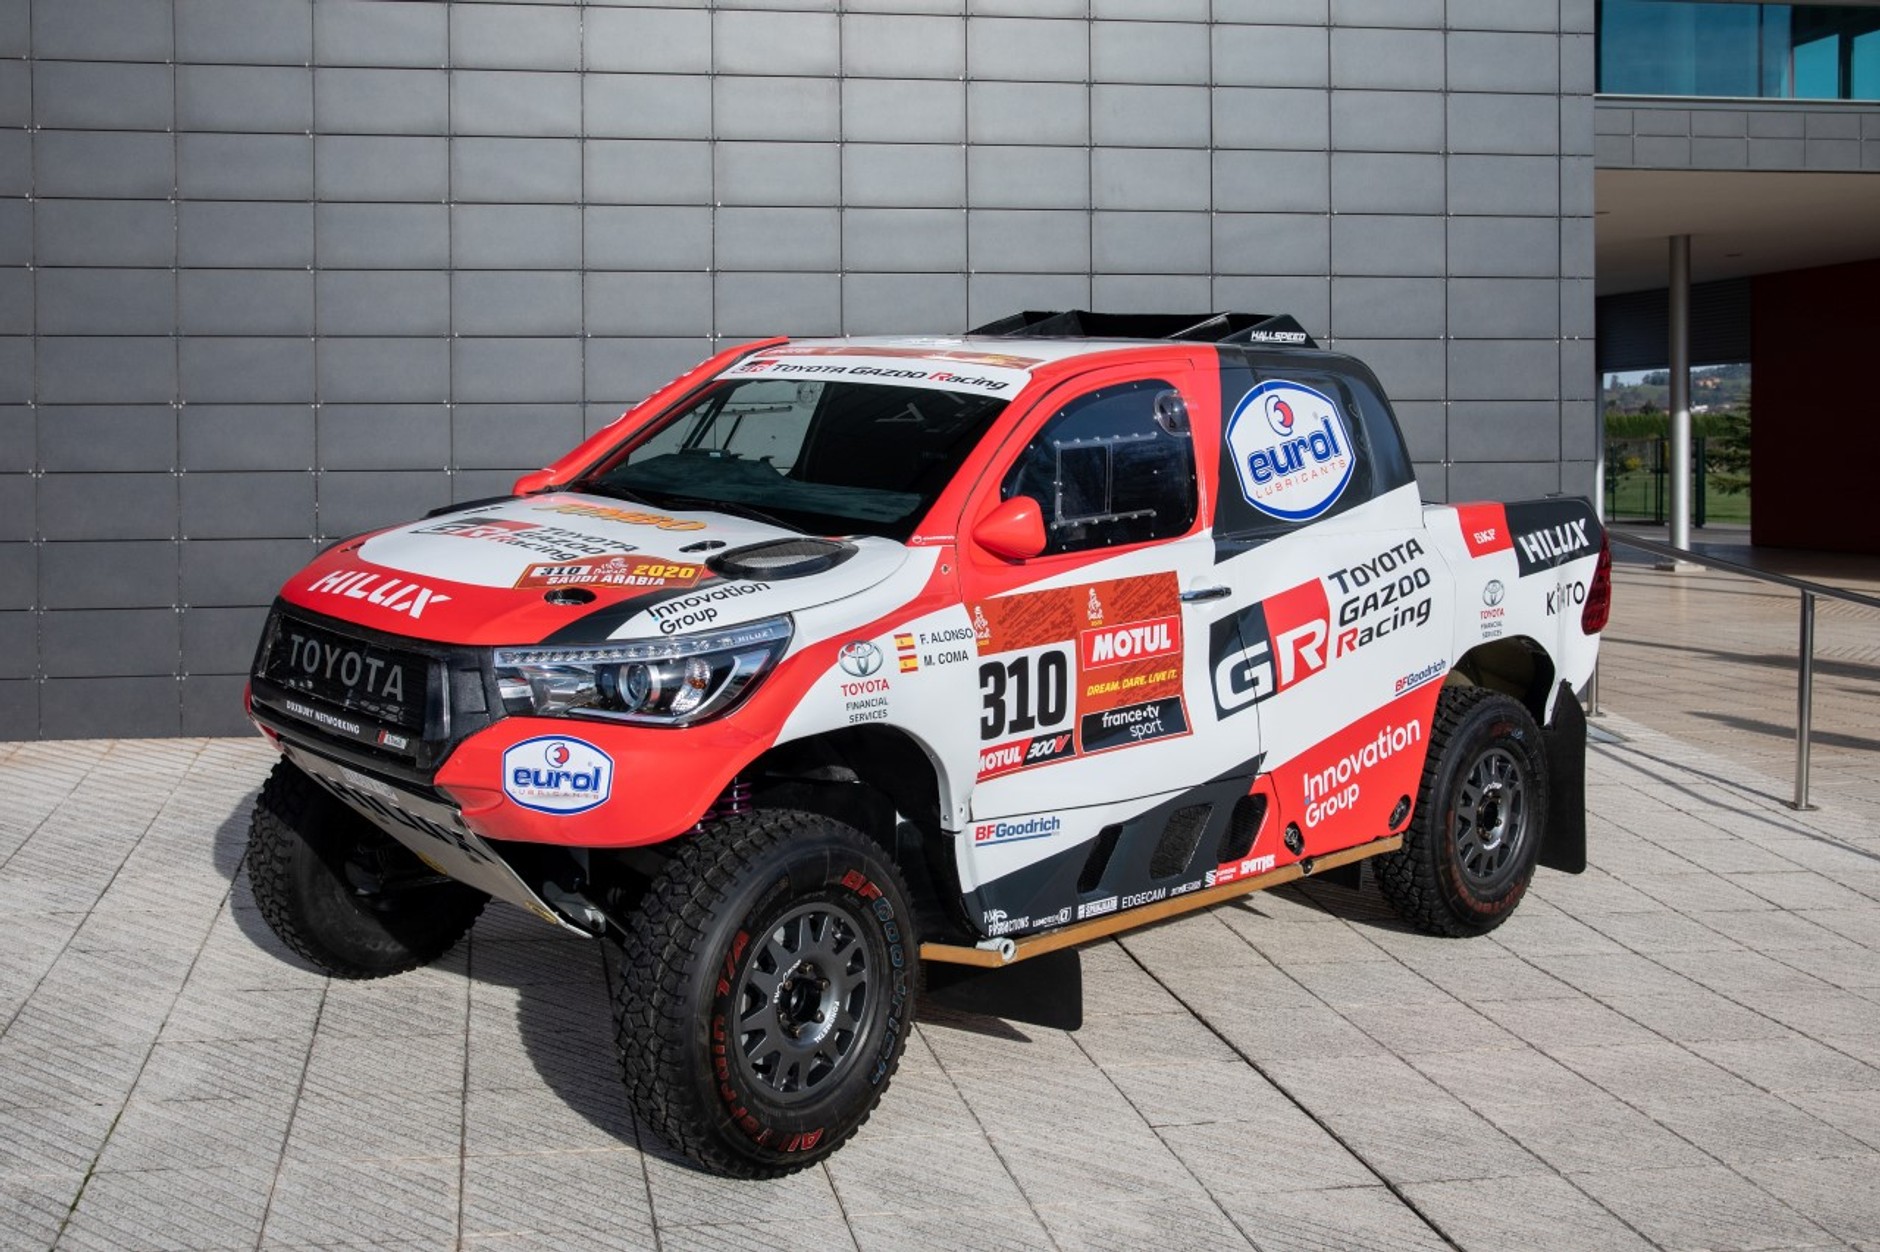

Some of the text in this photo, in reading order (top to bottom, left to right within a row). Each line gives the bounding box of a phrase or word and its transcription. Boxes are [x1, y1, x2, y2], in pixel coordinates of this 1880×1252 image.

[1251, 330, 1306, 342] HALLSPEED
[771, 363, 848, 375] TOYOTA
[848, 366, 928, 379] GAZOO
[928, 371, 1010, 390] Racing
[1247, 416, 1342, 485] eurol
[1255, 459, 1347, 499] LUBRICANTS
[488, 532, 580, 562] Racing
[513, 531, 607, 555] GAZOO
[537, 526, 640, 553] TOYOTA
[1517, 517, 1590, 563] HILUX
[541, 566, 582, 575] 310
[632, 564, 696, 578] 2020
[1327, 537, 1426, 595] TOYOTA
[546, 574, 666, 586] SAUDI ARABIA
[307, 570, 453, 620] HILUX
[645, 582, 771, 622] Innovation
[1338, 567, 1432, 628] GAZOO
[659, 607, 718, 635] Group
[1480, 607, 1505, 620] TOYOTA
[919, 633, 930, 645] F.
[930, 627, 974, 643] ALONSO
[1335, 597, 1432, 660] Racing
[1091, 623, 1172, 663] MOTUL
[290, 633, 404, 703] TOYOTA
[923, 650, 969, 666] M. COMA
[840, 678, 890, 697] TOYOTA
[1086, 680, 1121, 697] DREAM.
[1122, 674, 1147, 690] DARE.
[1148, 671, 1167, 684] LIVE
[1394, 659, 1447, 691] BFGoodrich
[845, 697, 889, 711] FINANCIAL
[978, 650, 1068, 741] 310
[286, 699, 360, 736] DUXBURY NETWORKING
[848, 709, 888, 724] SERVICES
[1129, 718, 1165, 741] sport
[1026, 733, 1072, 760] 300V
[1303, 719, 1421, 805] Innovation
[512, 766, 602, 792] eurol
[1305, 783, 1360, 828] Group
[975, 815, 1061, 842] BFGoodrich
[1122, 887, 1166, 909] EDGECAM
